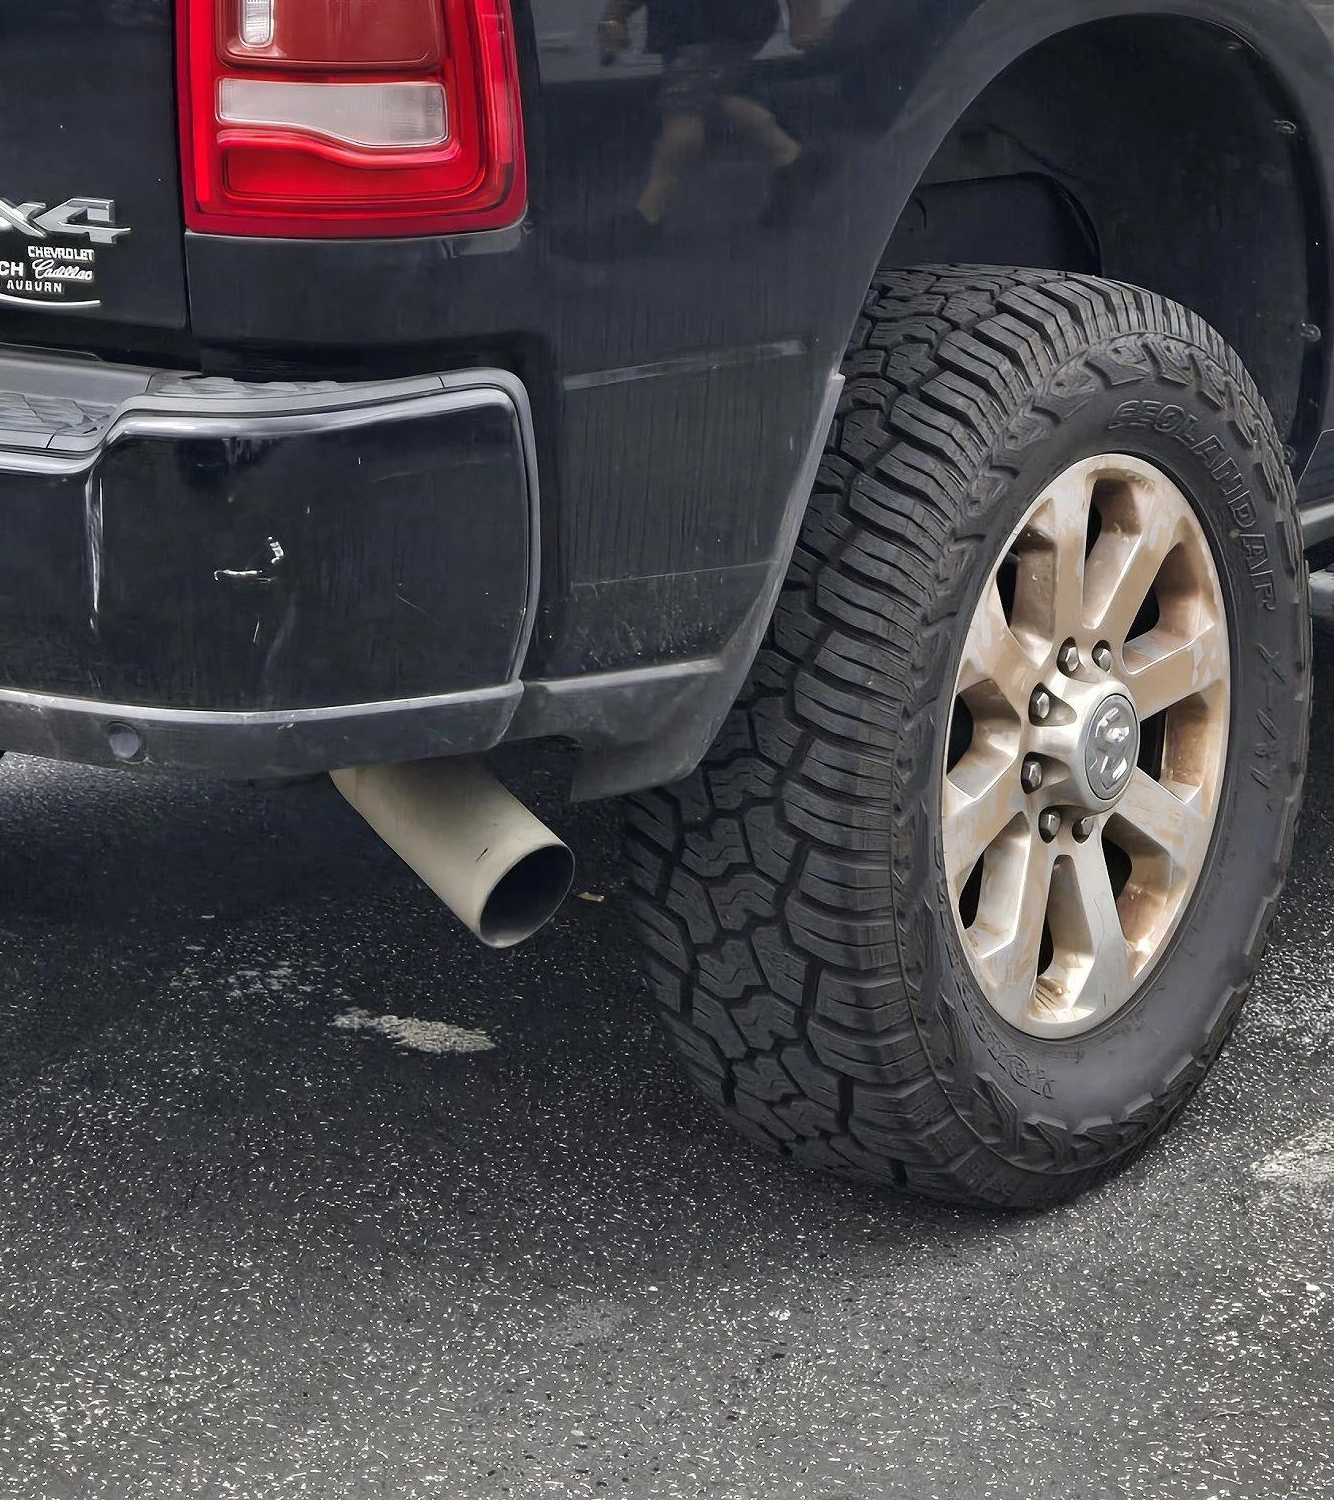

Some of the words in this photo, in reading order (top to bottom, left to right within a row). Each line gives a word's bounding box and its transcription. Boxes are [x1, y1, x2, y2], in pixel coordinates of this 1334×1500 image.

[27, 245, 95, 262] CHEVROLET
[31, 258, 94, 282] Cadillac
[7, 279, 62, 293] AUBURN
